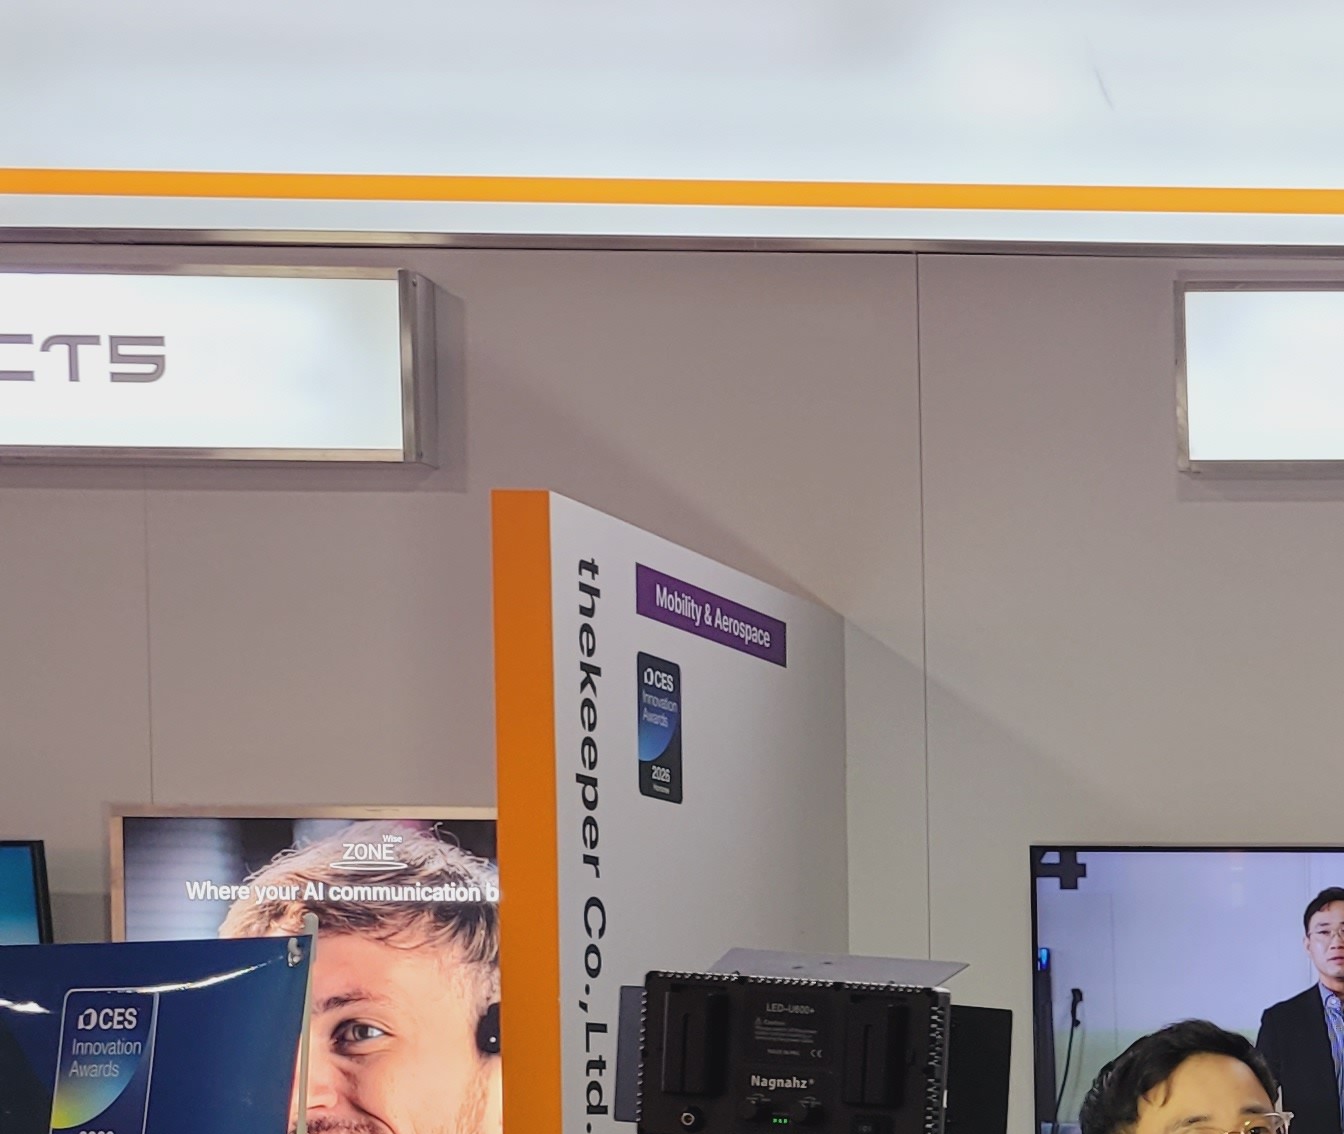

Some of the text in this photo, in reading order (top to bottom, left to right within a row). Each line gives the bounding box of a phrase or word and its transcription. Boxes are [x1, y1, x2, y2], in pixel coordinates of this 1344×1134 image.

[655, 583, 771, 648] Mobility & Aerospace
[654, 670, 674, 692] CES
[575, 557, 602, 879] thekeeper
[651, 765, 671, 783] 2026
[383, 834, 403, 844] Wise
[342, 843, 395, 861] ZONE
[185, 881, 250, 901] Where
[255, 883, 300, 905] your
[303, 882, 324, 901] AI
[329, 880, 482, 902] communication
[98, 1007, 139, 1031] CES
[71, 1037, 143, 1056] Innovation
[68, 1060, 121, 1079] Awards
[751, 1075, 808, 1091] Nagnahz
